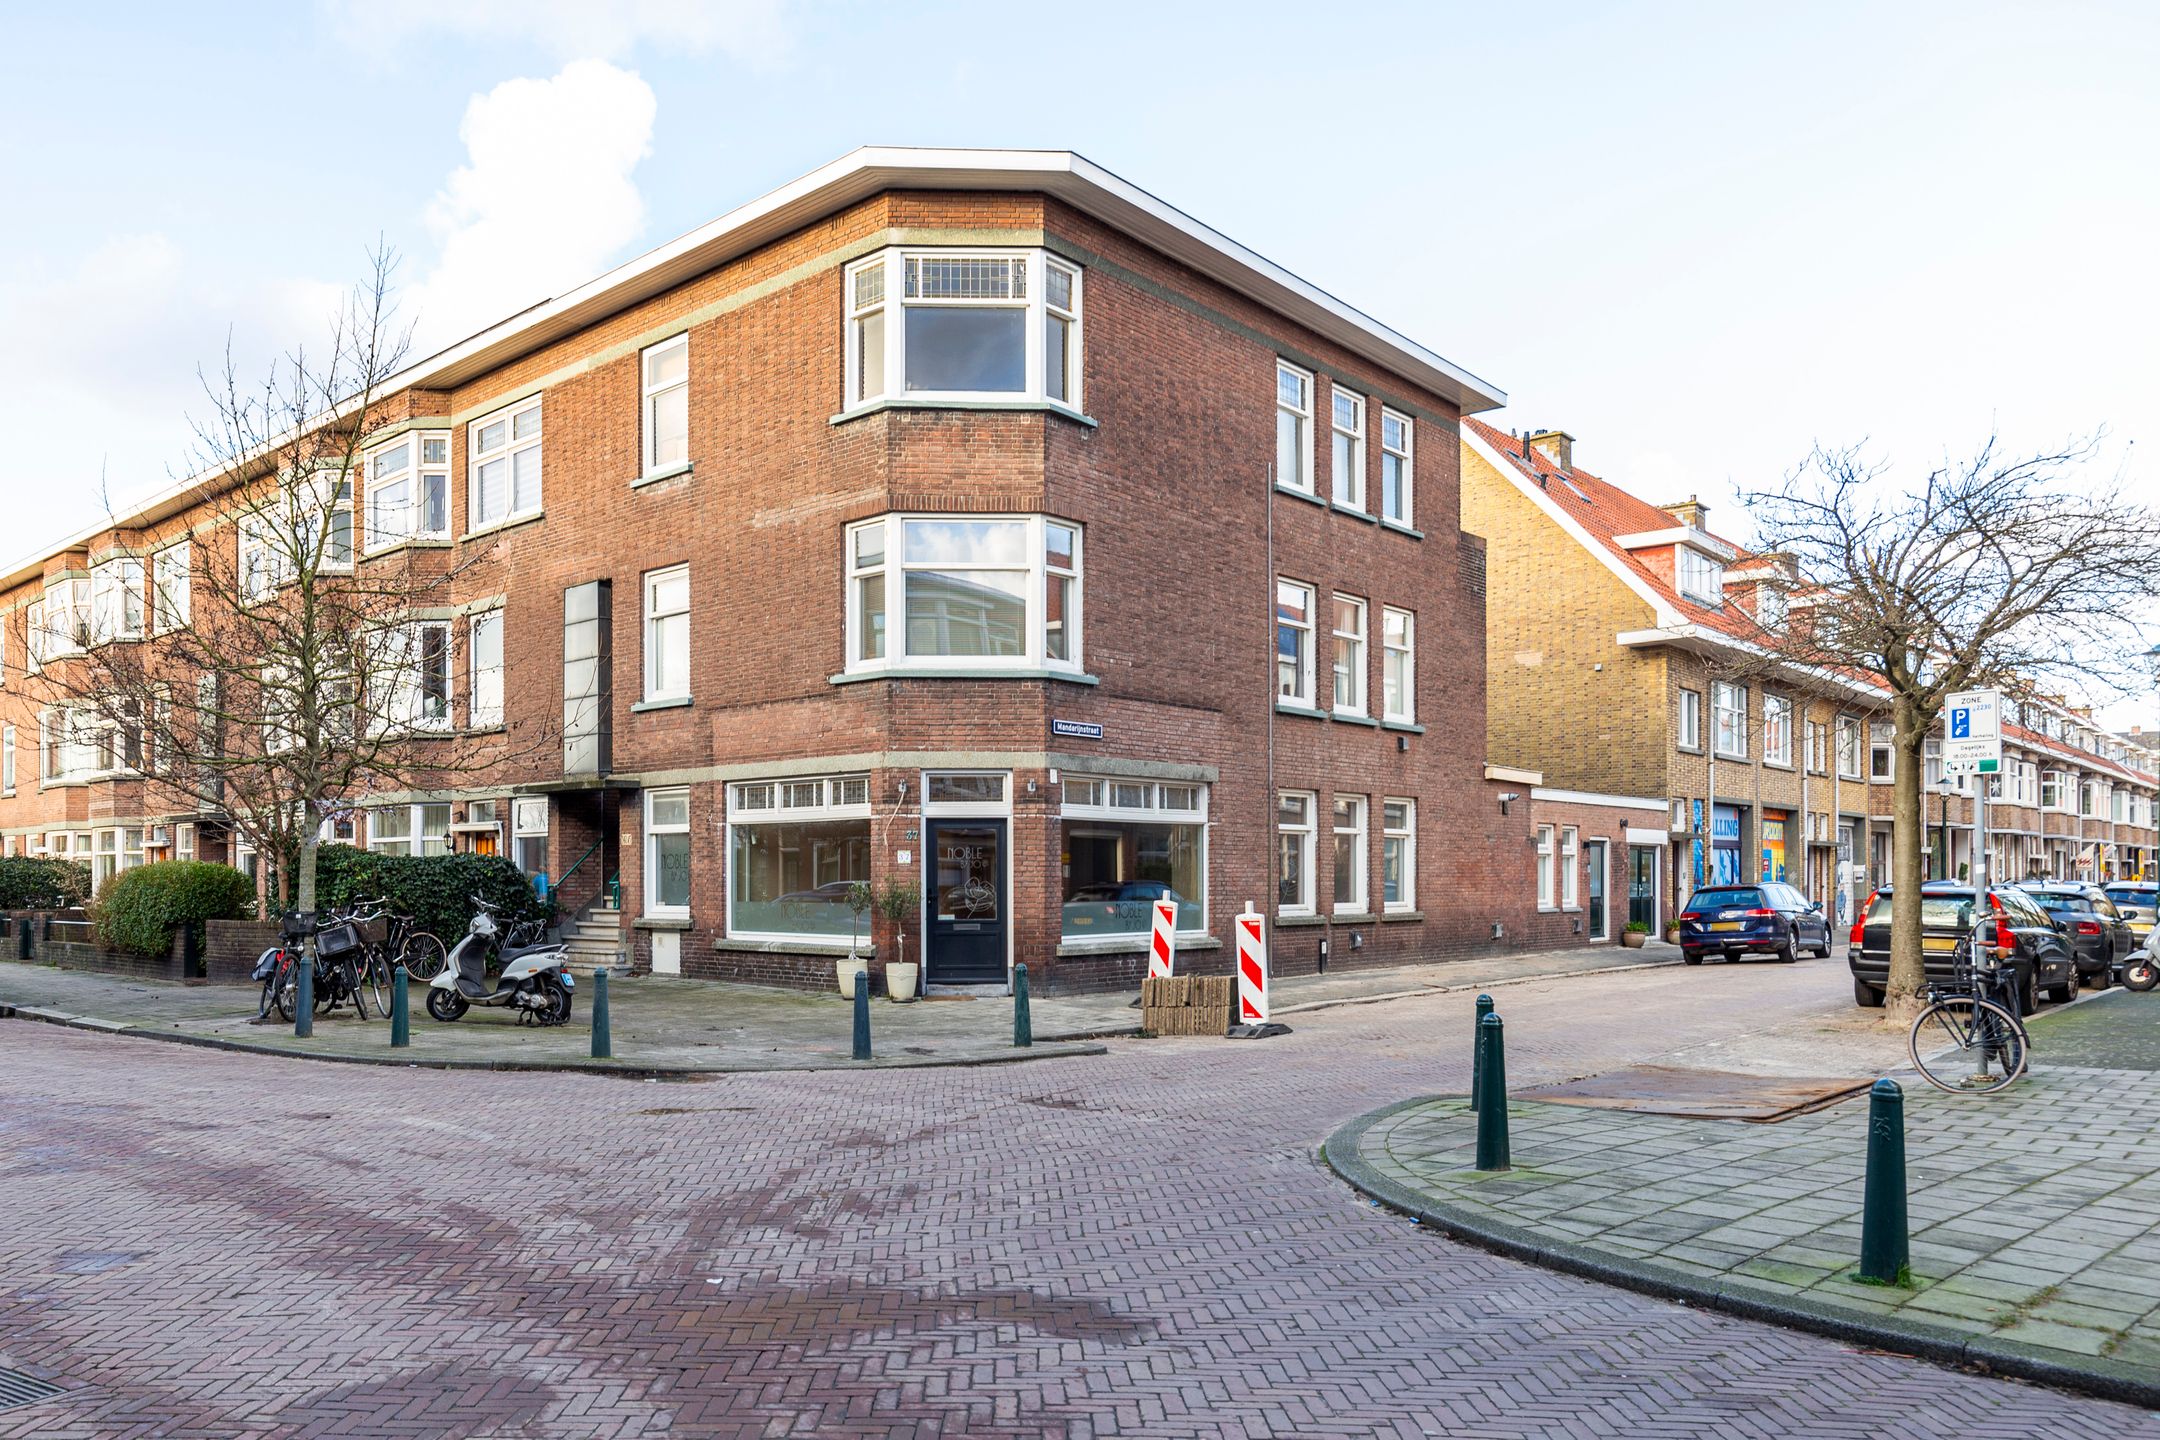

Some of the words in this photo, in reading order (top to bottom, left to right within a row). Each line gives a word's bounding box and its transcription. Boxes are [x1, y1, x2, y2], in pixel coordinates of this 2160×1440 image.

[1961, 696, 1982, 704] ZONE
[1956, 710, 1967, 725] P
[1057, 722, 1100, 735] Mandarijnstraat
[905, 830, 919, 840] 37
[947, 846, 983, 860] NOBLE
[661, 853, 689, 870] NOBLE
[1115, 903, 1143, 919] NOBLE
